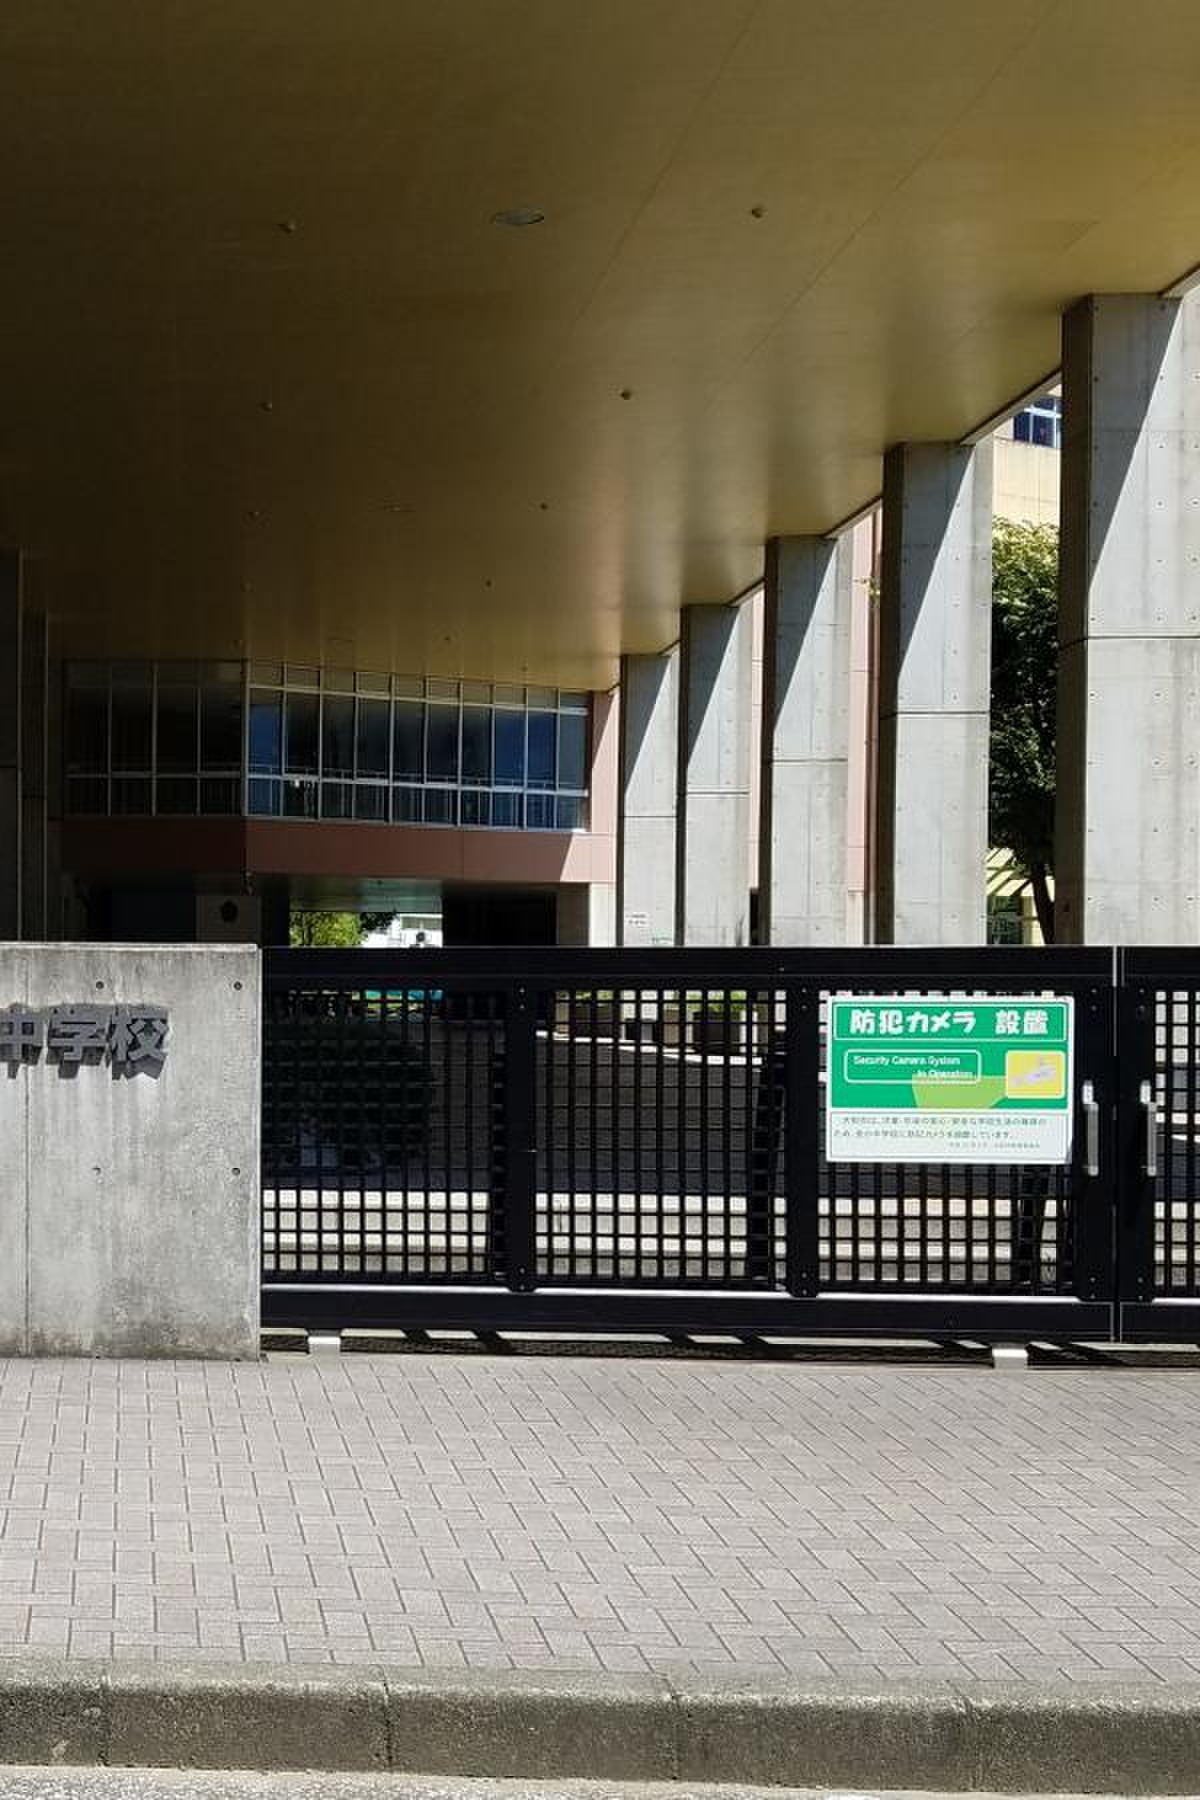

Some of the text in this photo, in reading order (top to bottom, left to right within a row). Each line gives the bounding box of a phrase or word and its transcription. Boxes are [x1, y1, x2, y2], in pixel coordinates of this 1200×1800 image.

[850, 1009, 1049, 1034] 防犯カメラ 設置
[854, 1056, 960, 1067] Security Camera System
[928, 1069, 973, 1079] Operation
